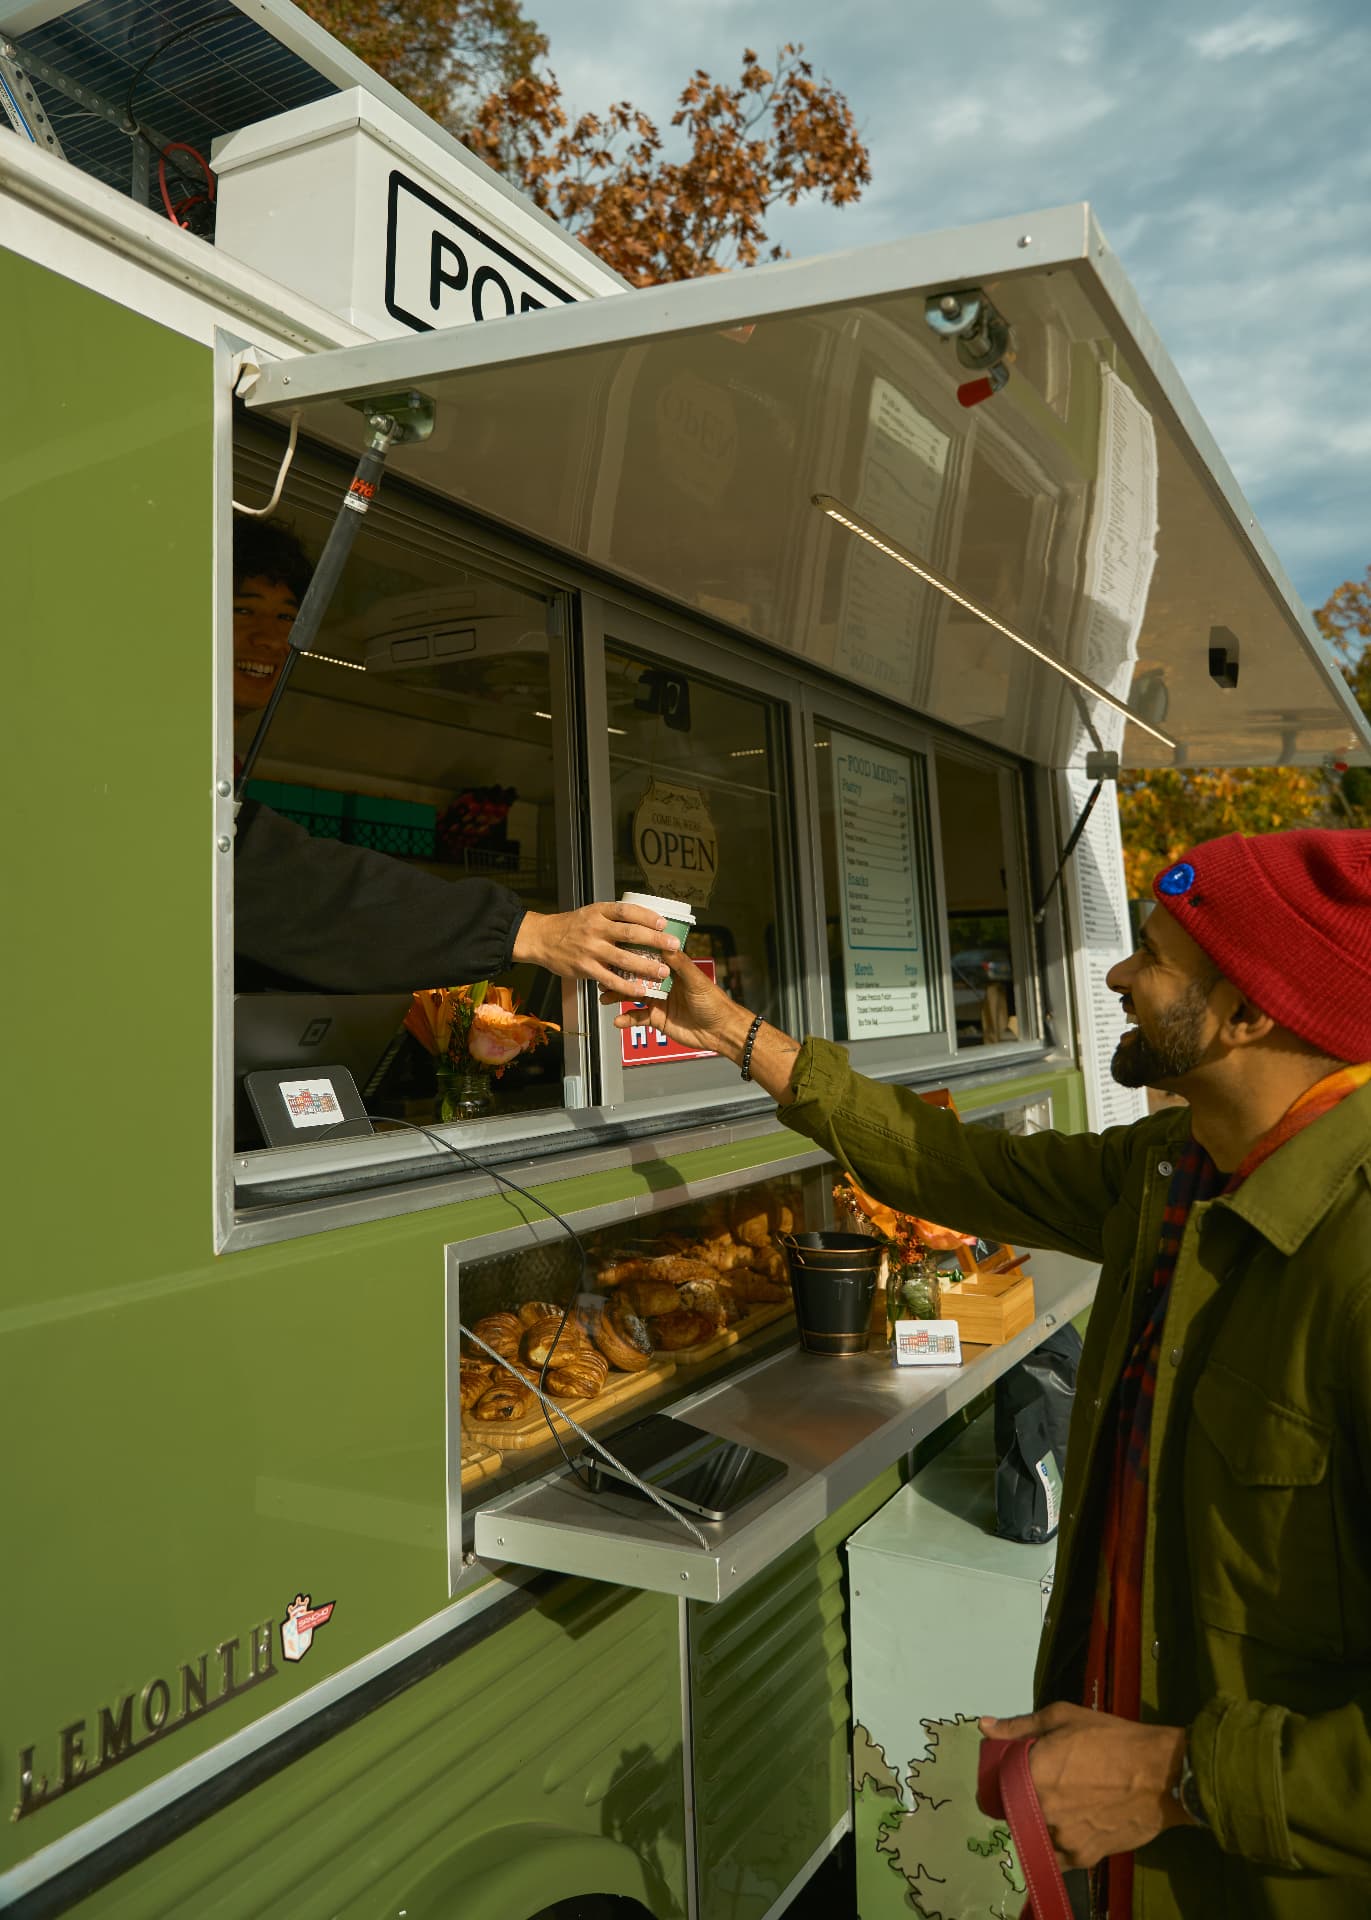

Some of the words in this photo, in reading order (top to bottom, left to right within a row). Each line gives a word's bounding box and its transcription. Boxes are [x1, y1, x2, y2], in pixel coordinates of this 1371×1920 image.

[430, 230, 547, 322] PO
[848, 755, 871, 777] FOOD
[871, 763, 899, 786] MENU
[640, 828, 715, 873] OPEN
[10, 1618, 277, 1823] LEMONTH
